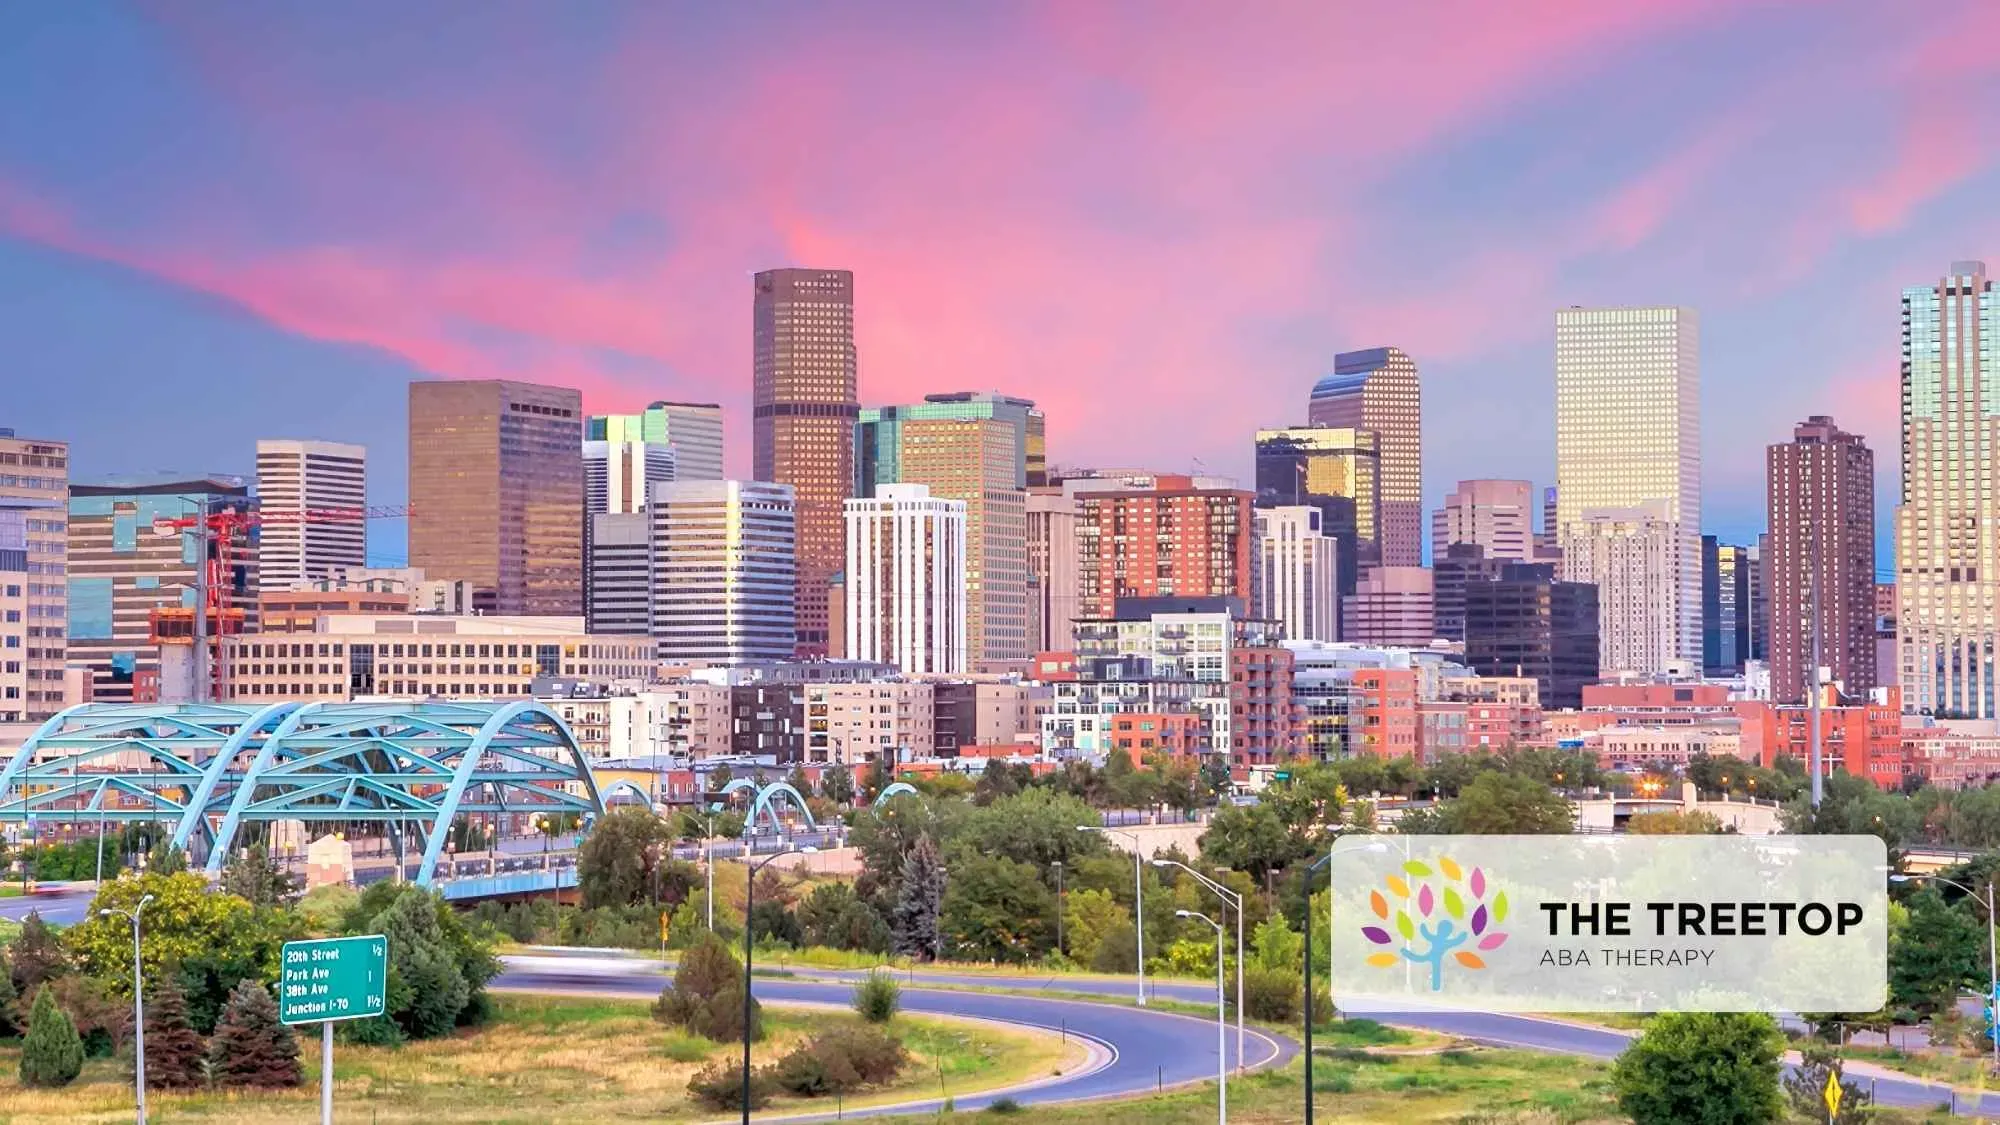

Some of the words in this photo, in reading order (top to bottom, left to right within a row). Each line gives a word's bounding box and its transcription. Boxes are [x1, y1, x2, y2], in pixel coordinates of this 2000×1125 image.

[286, 950, 309, 963] 20th
[311, 948, 340, 961] Street
[286, 968, 309, 981] Park
[311, 967, 330, 980] Ave
[286, 984, 308, 997] 38th
[310, 983, 329, 995] Ave
[285, 1001, 327, 1015] Junction
[329, 998, 349, 1011] I-70
